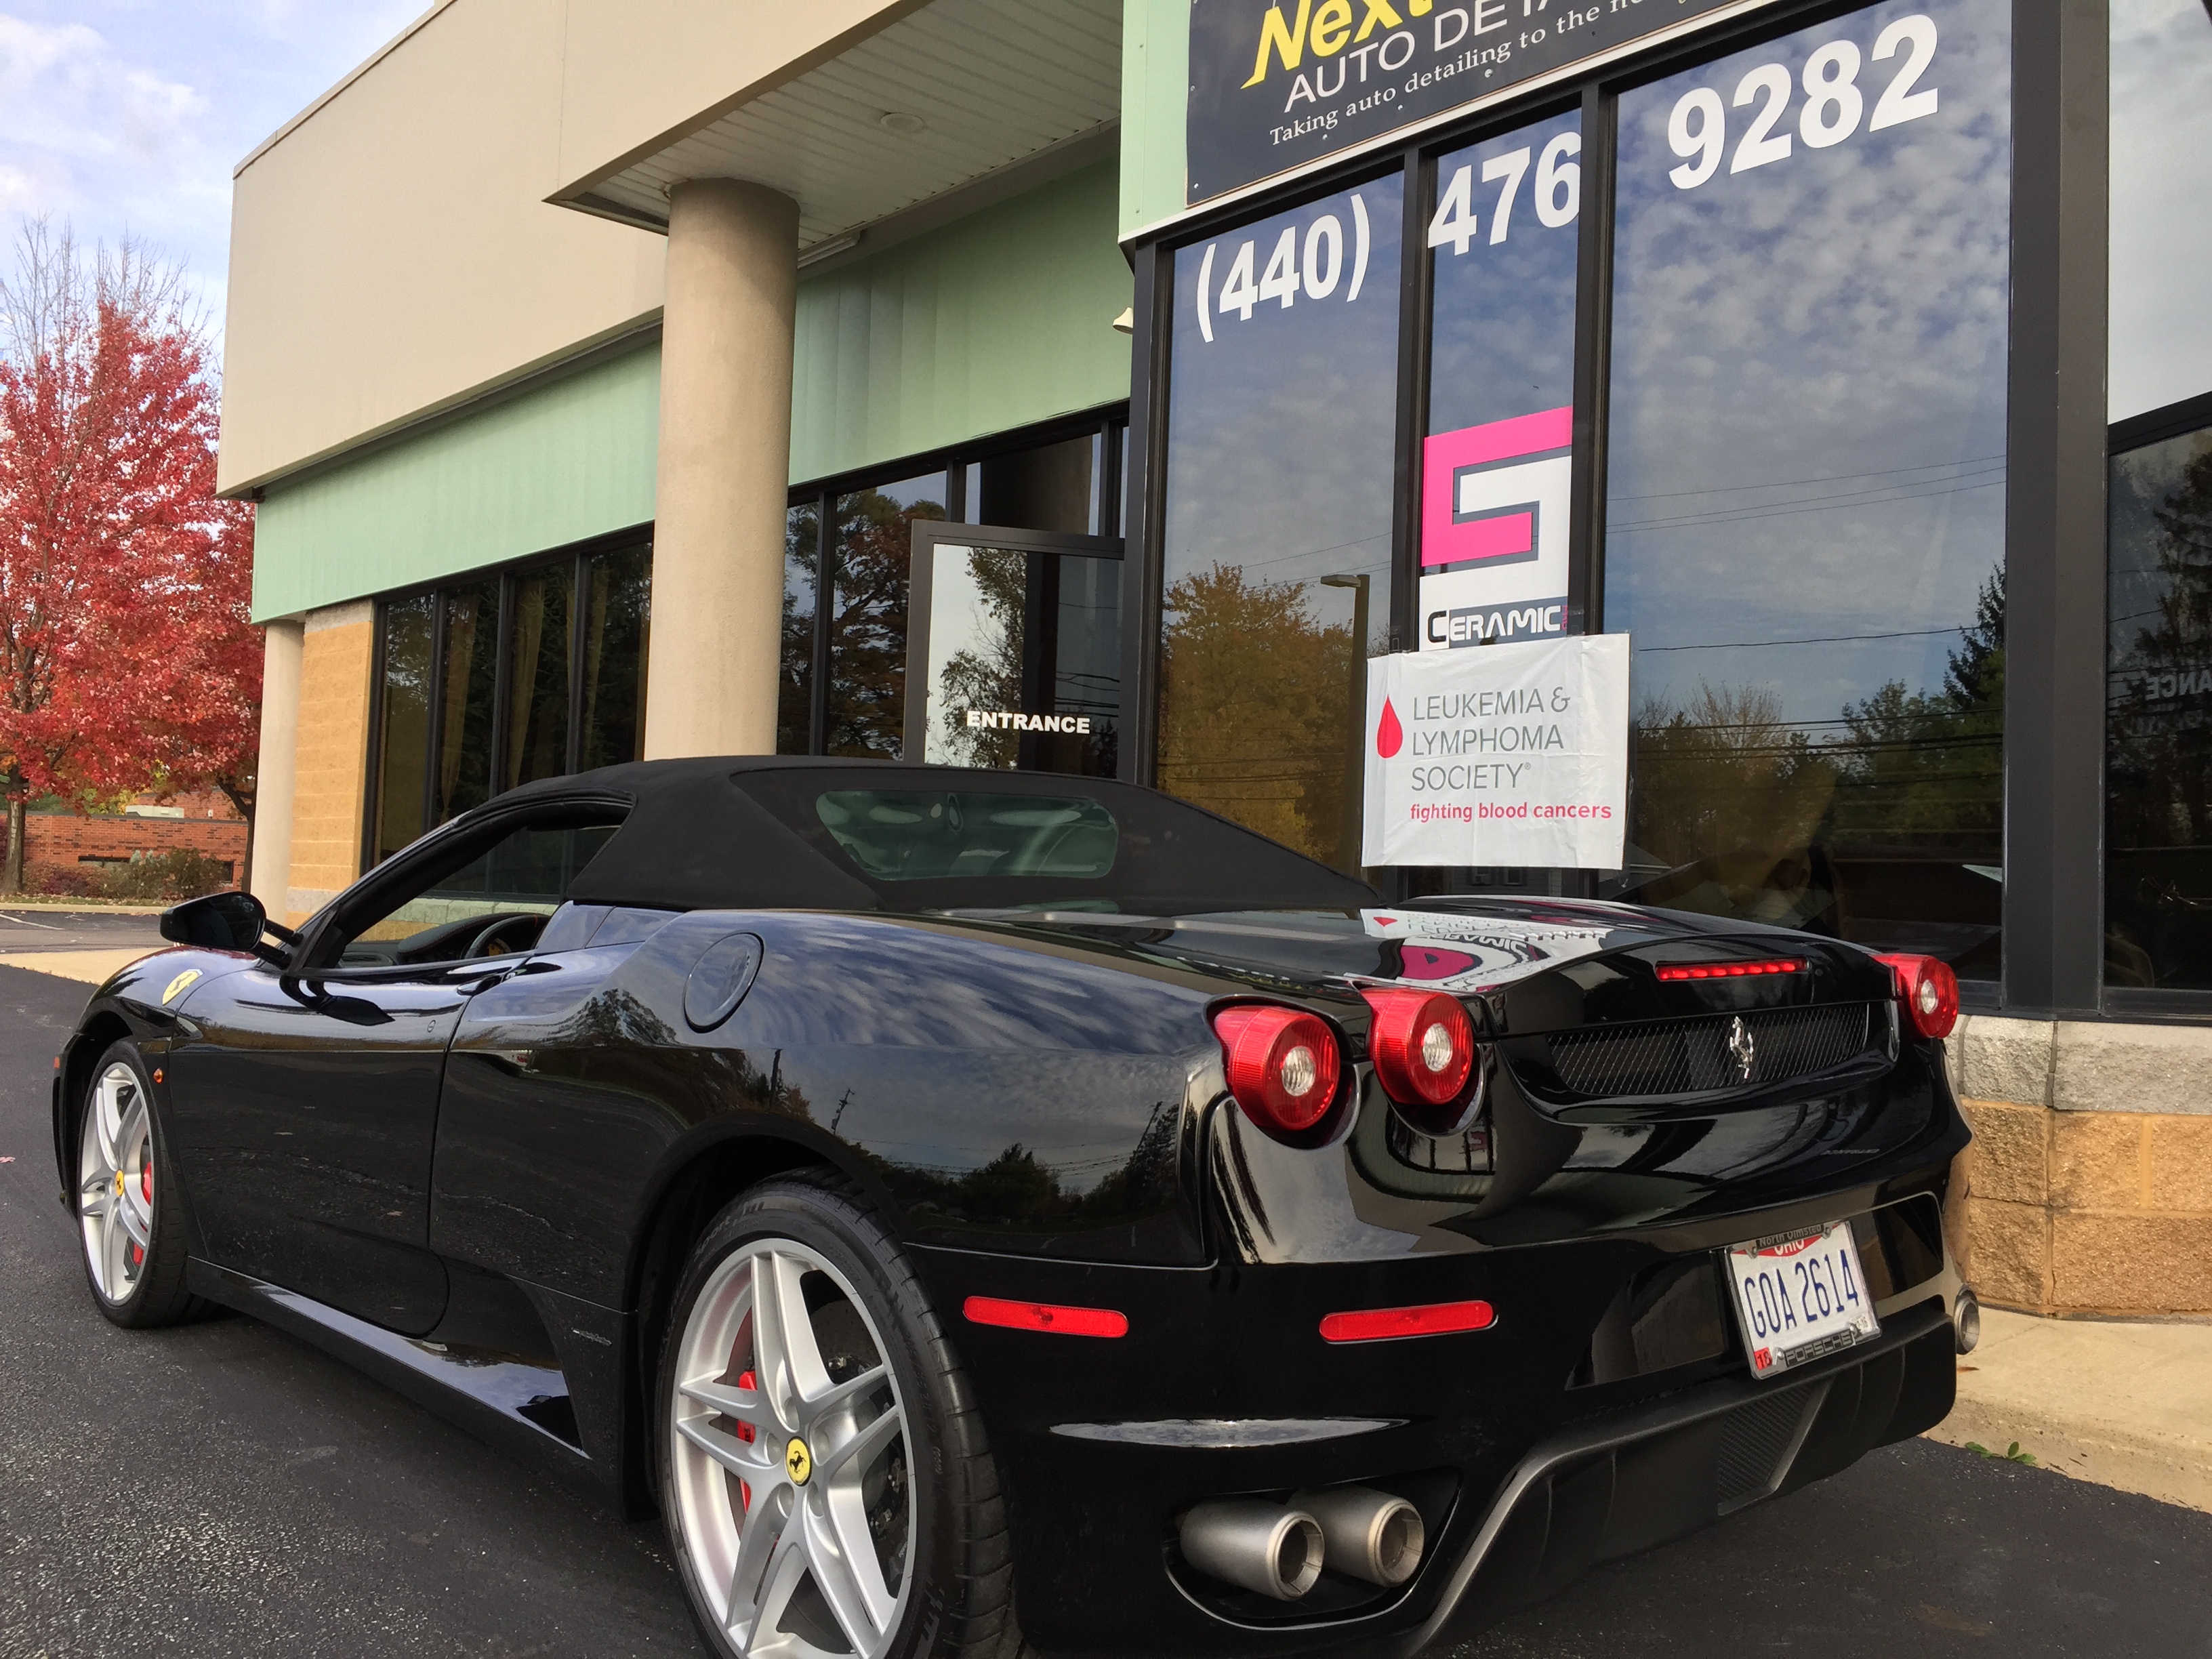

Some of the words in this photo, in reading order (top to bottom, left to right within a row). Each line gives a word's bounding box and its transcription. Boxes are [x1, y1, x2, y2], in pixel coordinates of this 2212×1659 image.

[1269, 110, 1338, 146] Taking
[1345, 87, 1396, 117] auto
[1404, 41, 1512, 94] detailing
[1519, 28, 1547, 48] to
[1556, 6, 1600, 35] the
[1284, 30, 1416, 113] AUTO
[1197, 193, 1370, 343] (440)
[1428, 131, 1581, 255] 476
[1668, 14, 1938, 189] 9282
[1427, 605, 1562, 643] CERAMIC
[1413, 688, 1544, 721] LEUKEMIA
[1551, 686, 1571, 713] &
[966, 710, 1090, 734] ENTRANCE
[1412, 724, 1564, 756] LYMPHOMA
[1410, 803, 1473, 823] fighting
[1478, 802, 1528, 819] blood
[1533, 804, 1612, 819] cancers
[1759, 1233, 1785, 1247] North
[1744, 1268, 1797, 1338] GOA
[1795, 1248, 1860, 1323] 2614
[1785, 1330, 1853, 1365] PORSCHE
